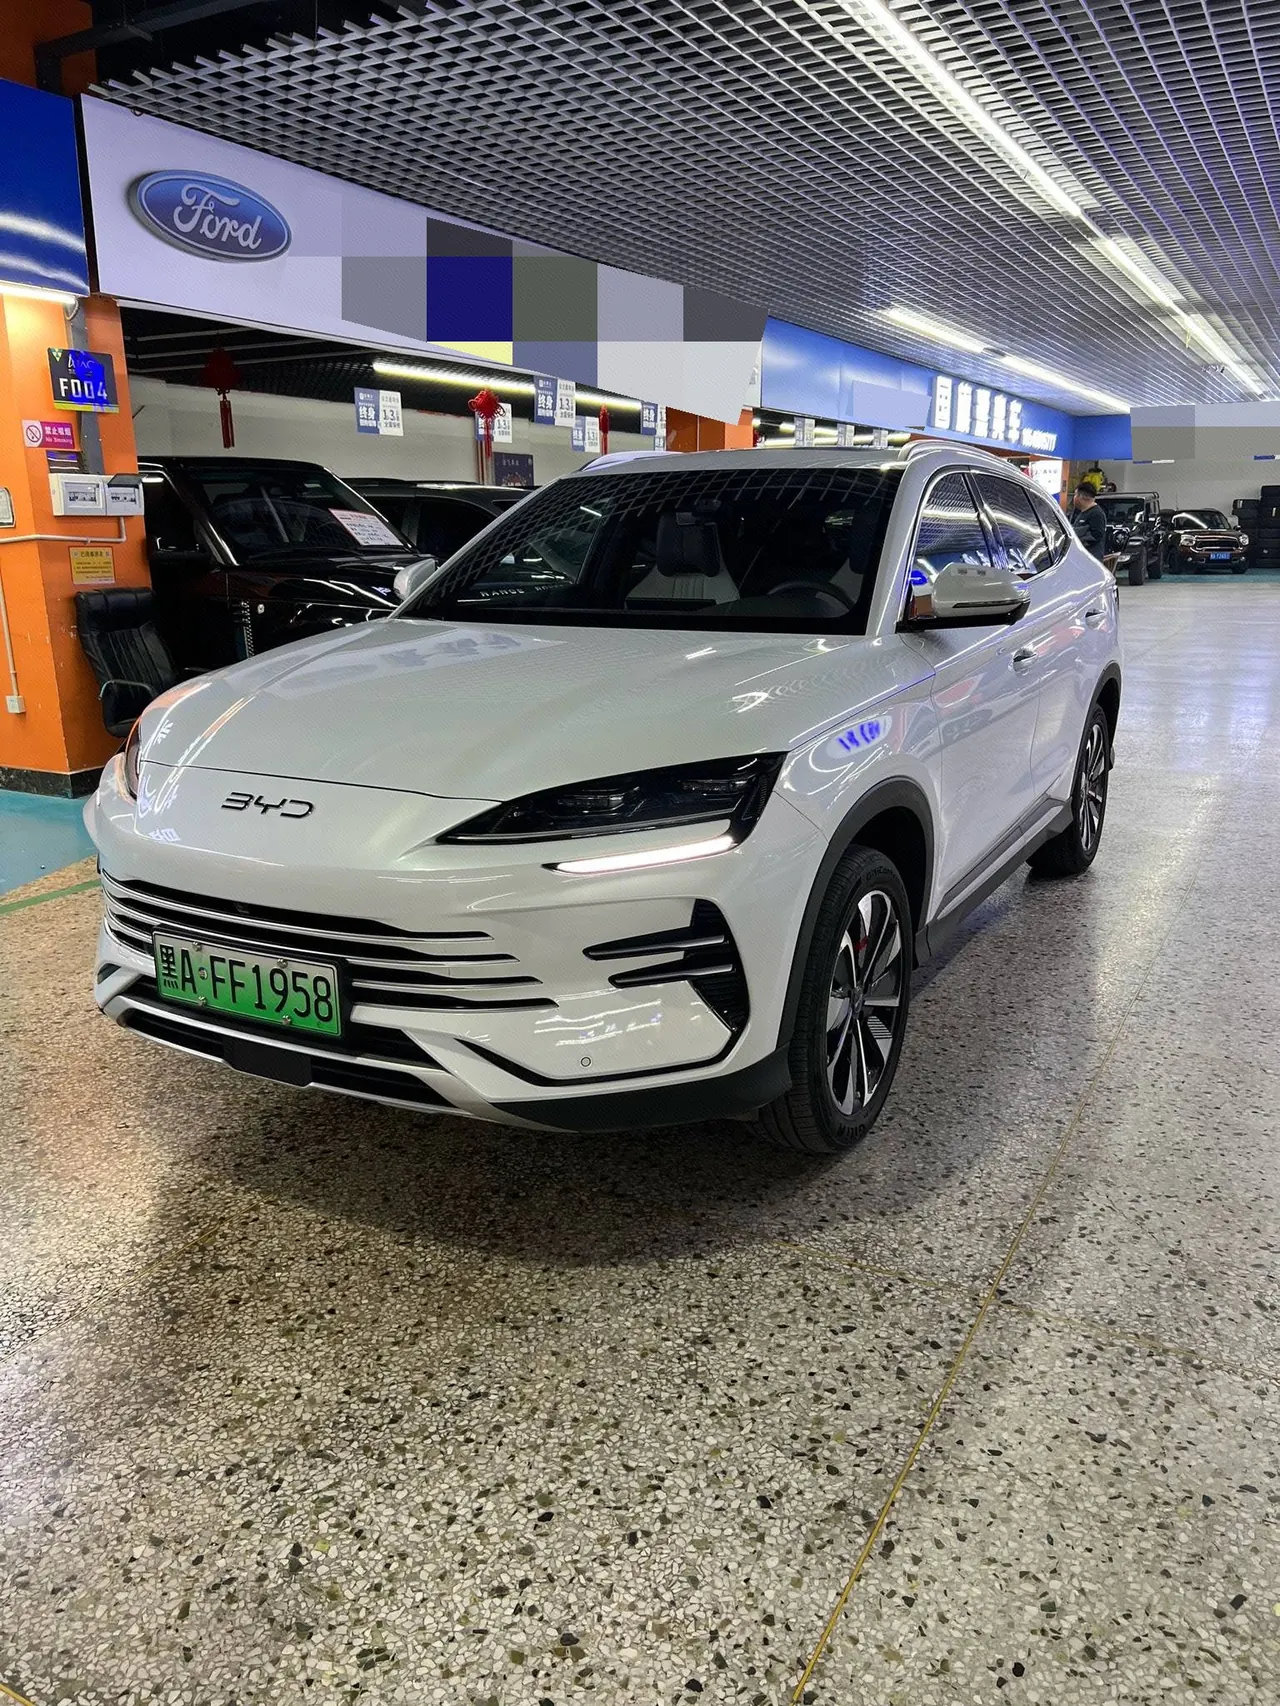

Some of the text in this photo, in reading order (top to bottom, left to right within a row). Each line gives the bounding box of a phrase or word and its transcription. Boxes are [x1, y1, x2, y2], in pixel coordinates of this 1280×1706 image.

[173, 183, 262, 250] Ford
[59, 377, 108, 400] F004
[538, 394, 554, 410] 终身
[44, 426, 72, 436] 禁止吸烟
[53, 437, 73, 445] Smoking
[479, 588, 525, 598] RANGE
[221, 791, 315, 819] BYD
